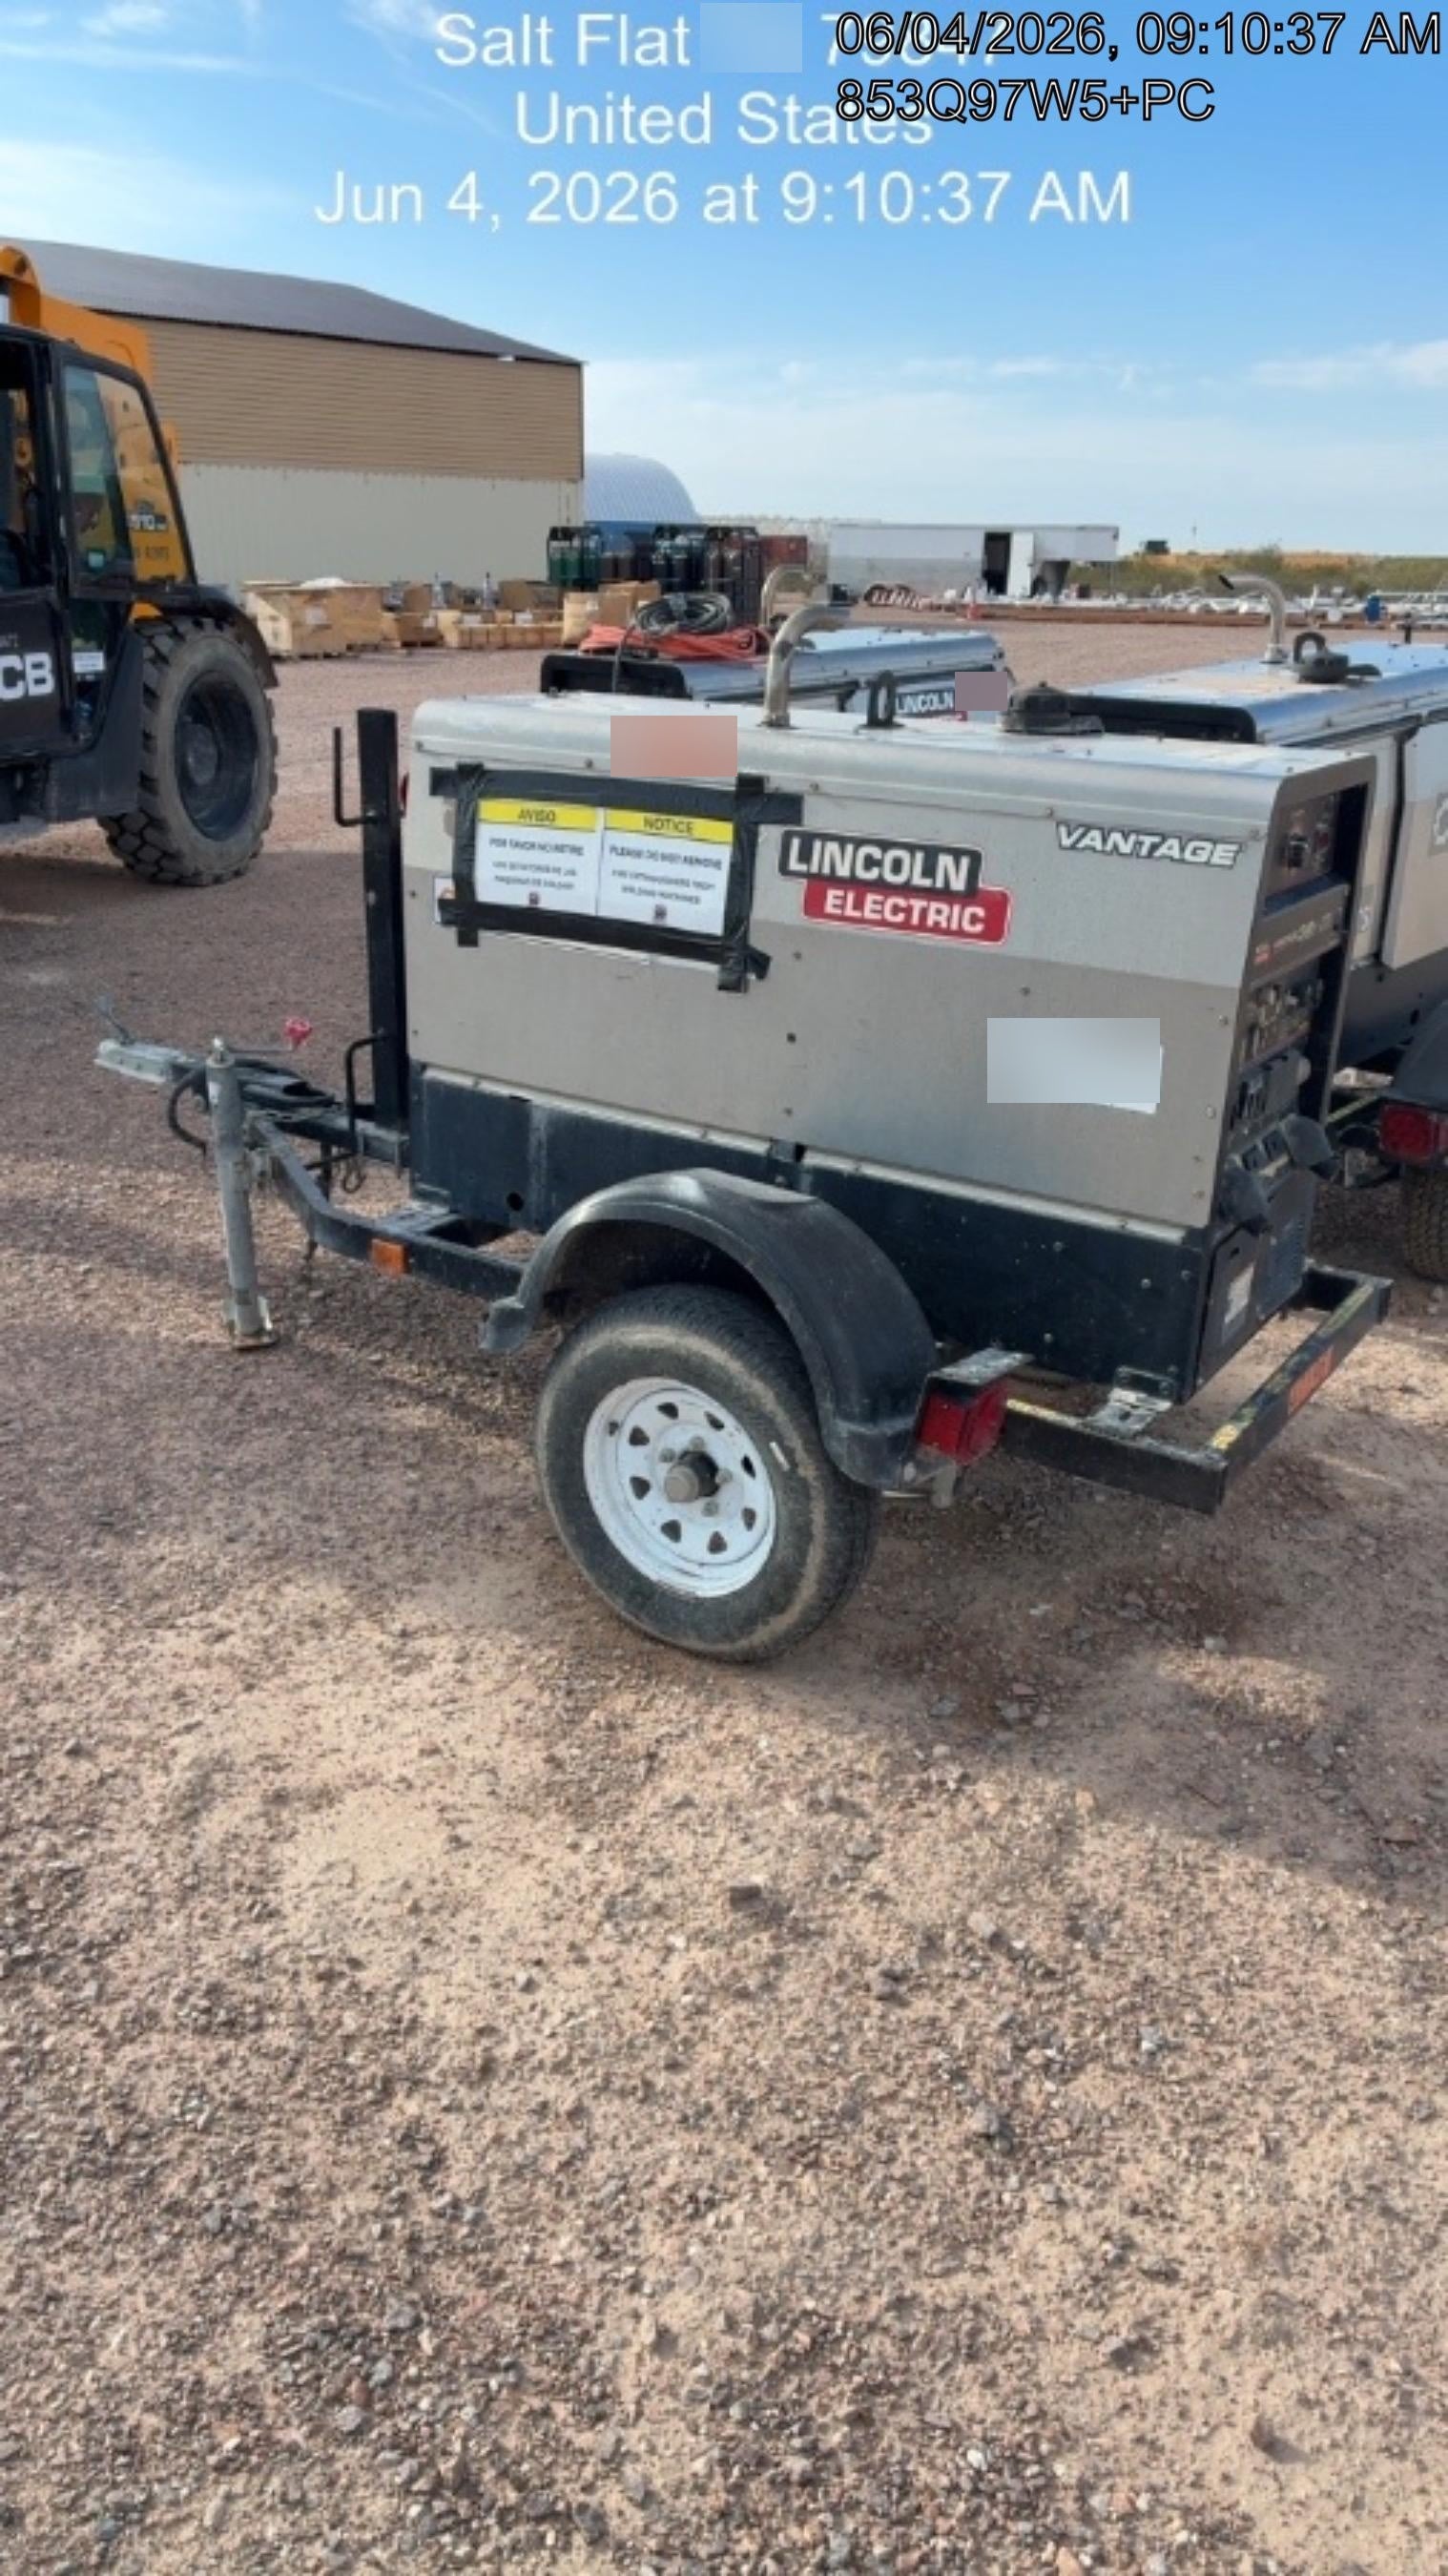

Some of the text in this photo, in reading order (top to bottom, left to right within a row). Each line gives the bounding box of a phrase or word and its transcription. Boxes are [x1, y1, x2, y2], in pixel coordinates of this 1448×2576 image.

[896, 691, 955, 714] LINCOLN
[517, 806, 557, 823] AVISO
[642, 816, 695, 836] NOTICE
[1056, 823, 1242, 868] VANTAGE
[787, 839, 972, 891] LINCOLN
[823, 888, 986, 934] ELECTRIC
